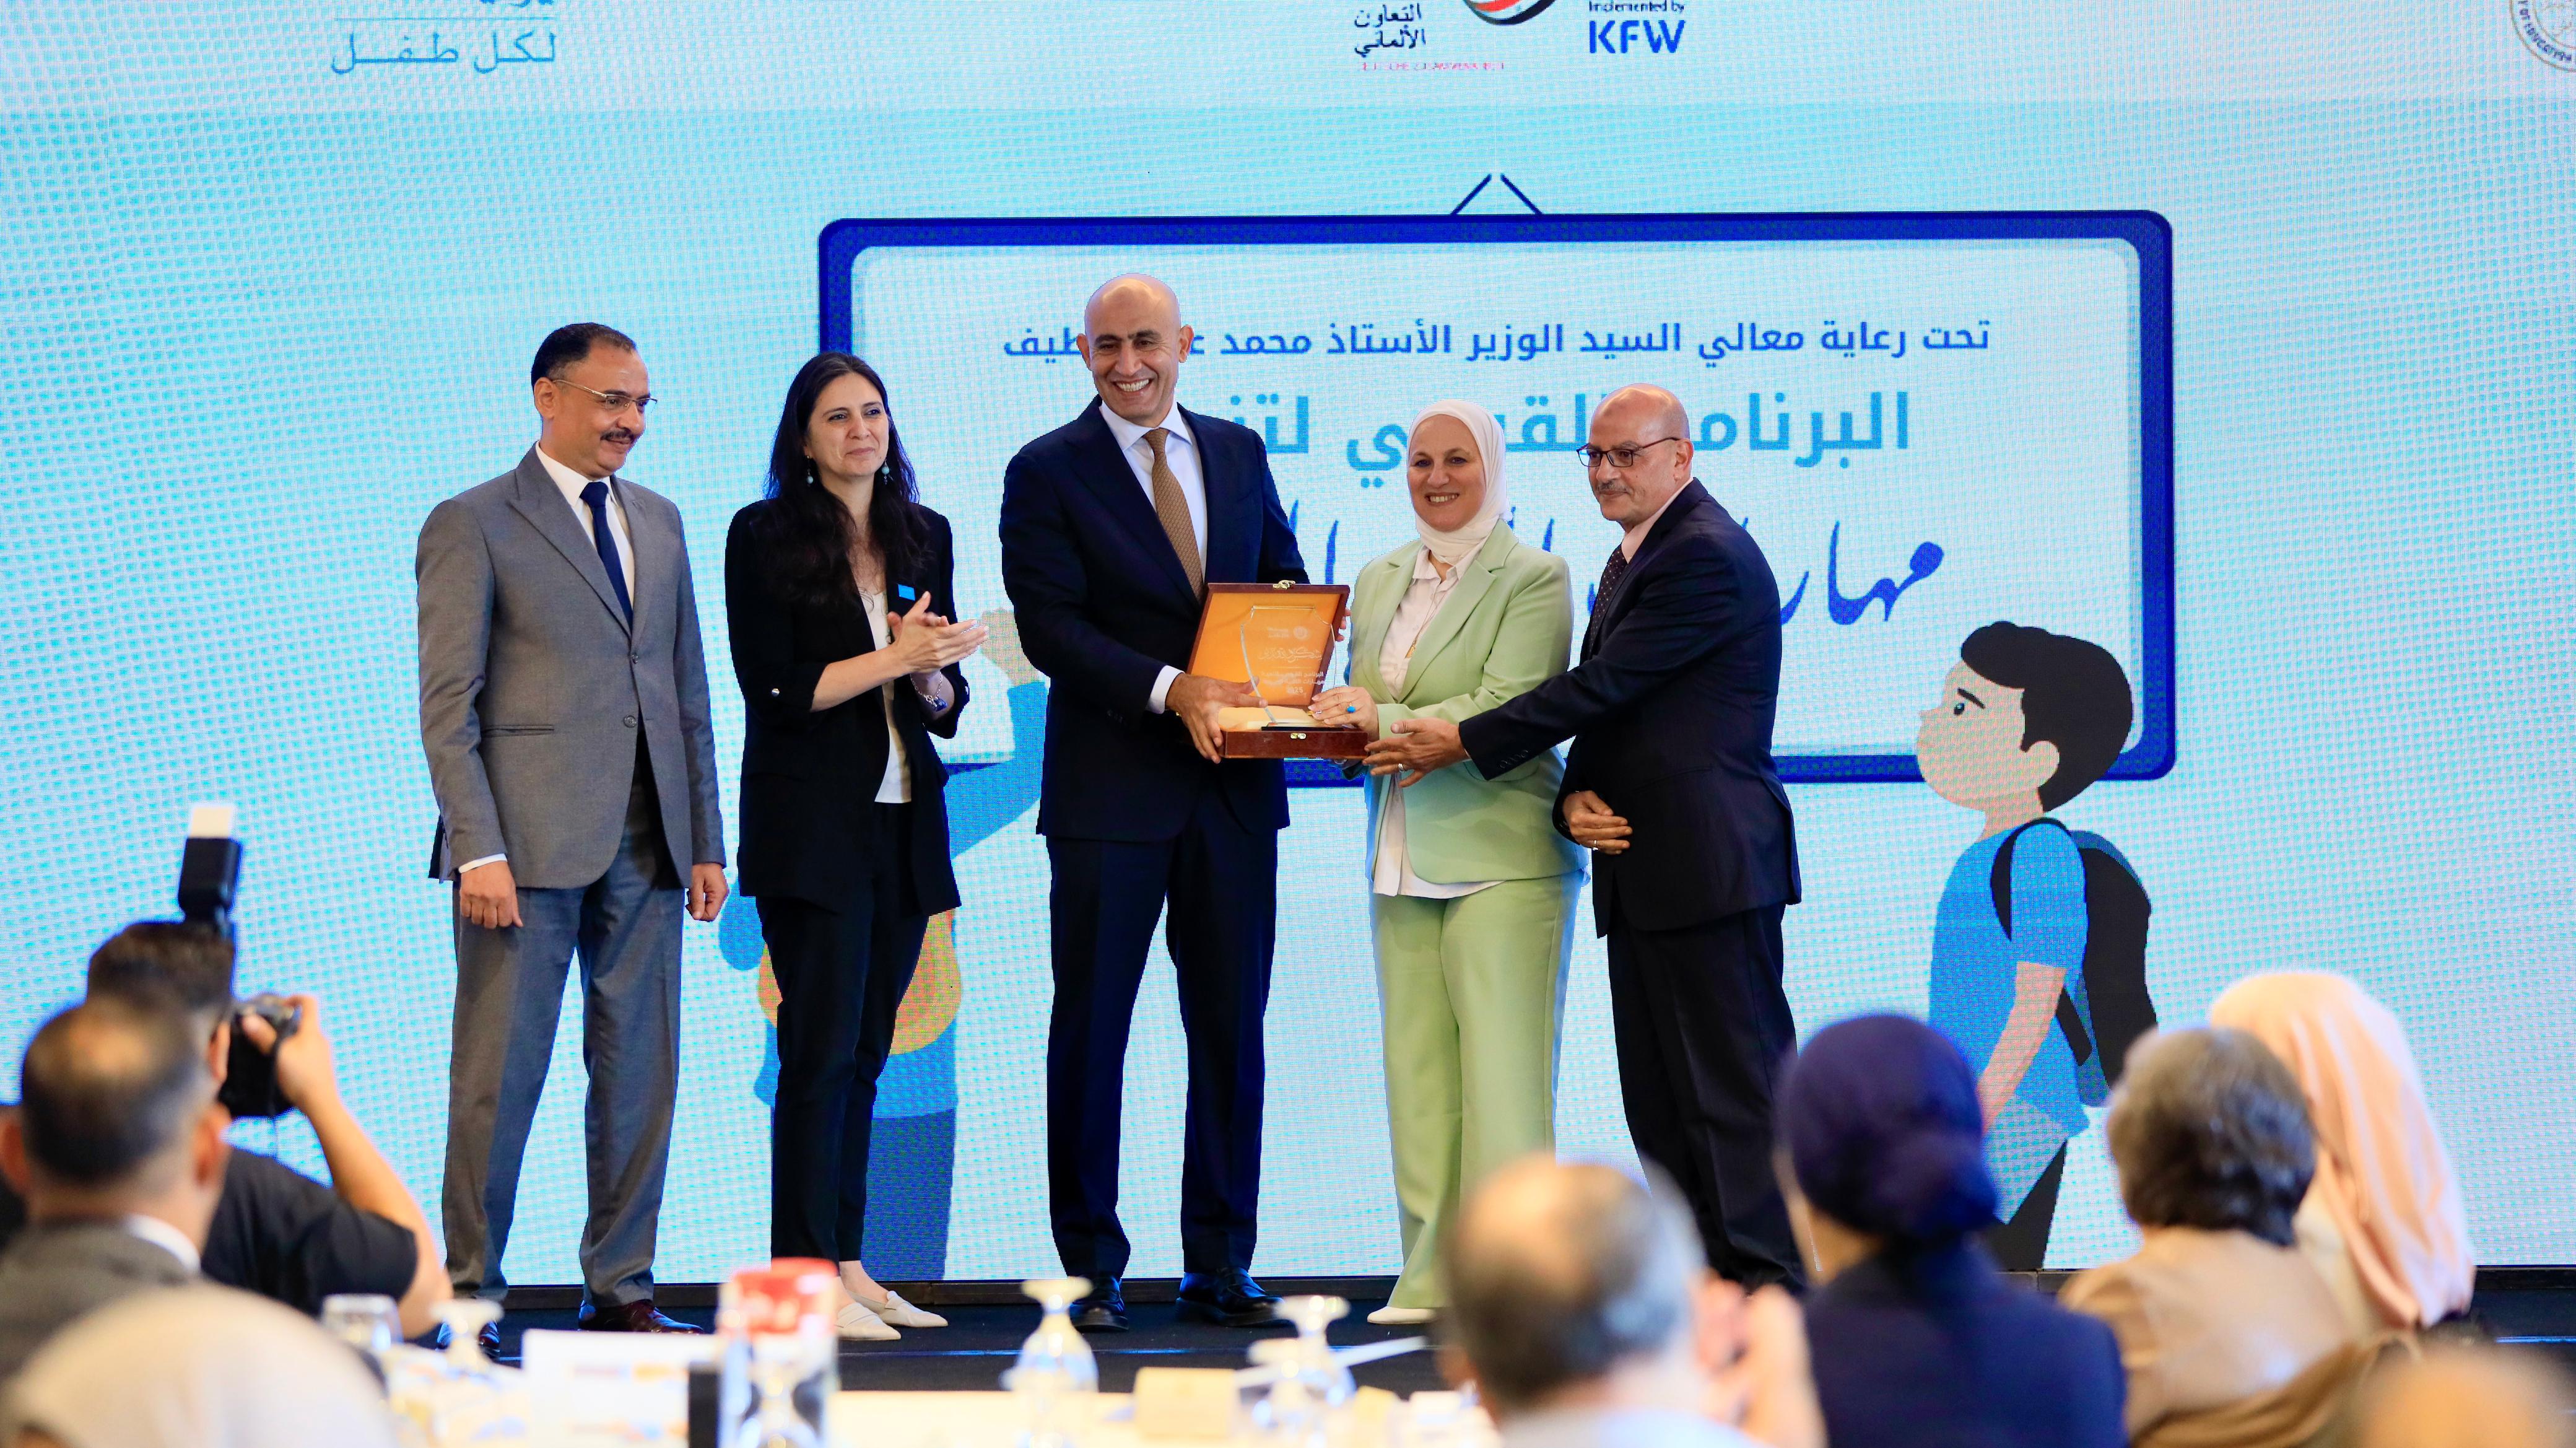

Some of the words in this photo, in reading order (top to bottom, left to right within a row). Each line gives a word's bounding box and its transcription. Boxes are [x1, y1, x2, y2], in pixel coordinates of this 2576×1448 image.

[1354, 2, 1422, 27] التعاون
[331, 31, 458, 75] طفل
[474, 30, 555, 74] لكل
[1354, 25, 1426, 58] الألماني
[1221, 333, 1312, 355] محمد
[1327, 318, 1451, 354] الأستاذ
[1466, 324, 1563, 362] الوزير
[1580, 323, 1681, 359] السيد
[1697, 322, 1804, 368] معالي
[1821, 321, 1906, 358] رعاية
[1922, 320, 1990, 349] تحت
